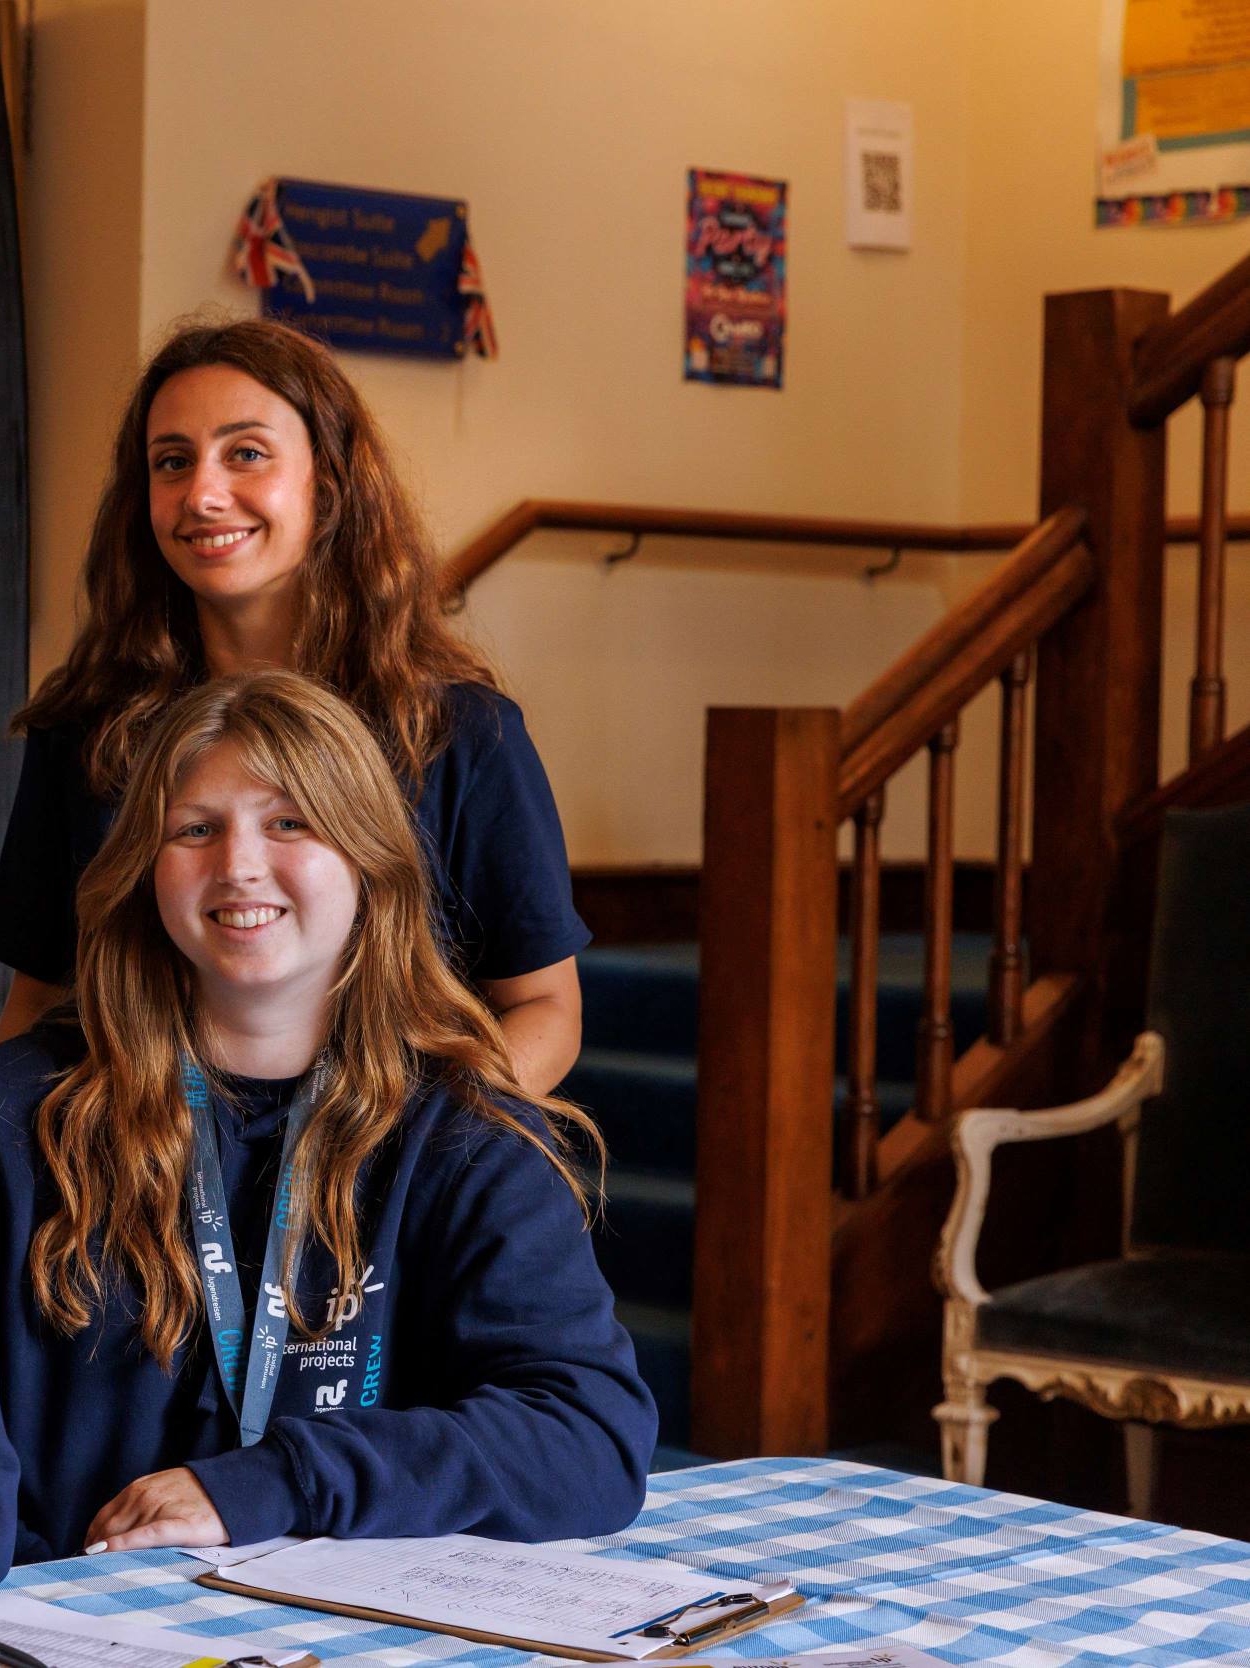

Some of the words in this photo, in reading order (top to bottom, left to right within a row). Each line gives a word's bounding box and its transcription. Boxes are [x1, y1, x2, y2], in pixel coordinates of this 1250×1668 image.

[191, 1186, 201, 1210] projects
[196, 1171, 208, 1208] international
[198, 1209, 216, 1224] ip
[207, 1275, 222, 1321] Jugendreisen
[261, 1336, 279, 1349] ip
[261, 1351, 272, 1389] international
[269, 1352, 278, 1377] projects
[300, 1353, 355, 1371] projects
[360, 1335, 382, 1408] CREW
